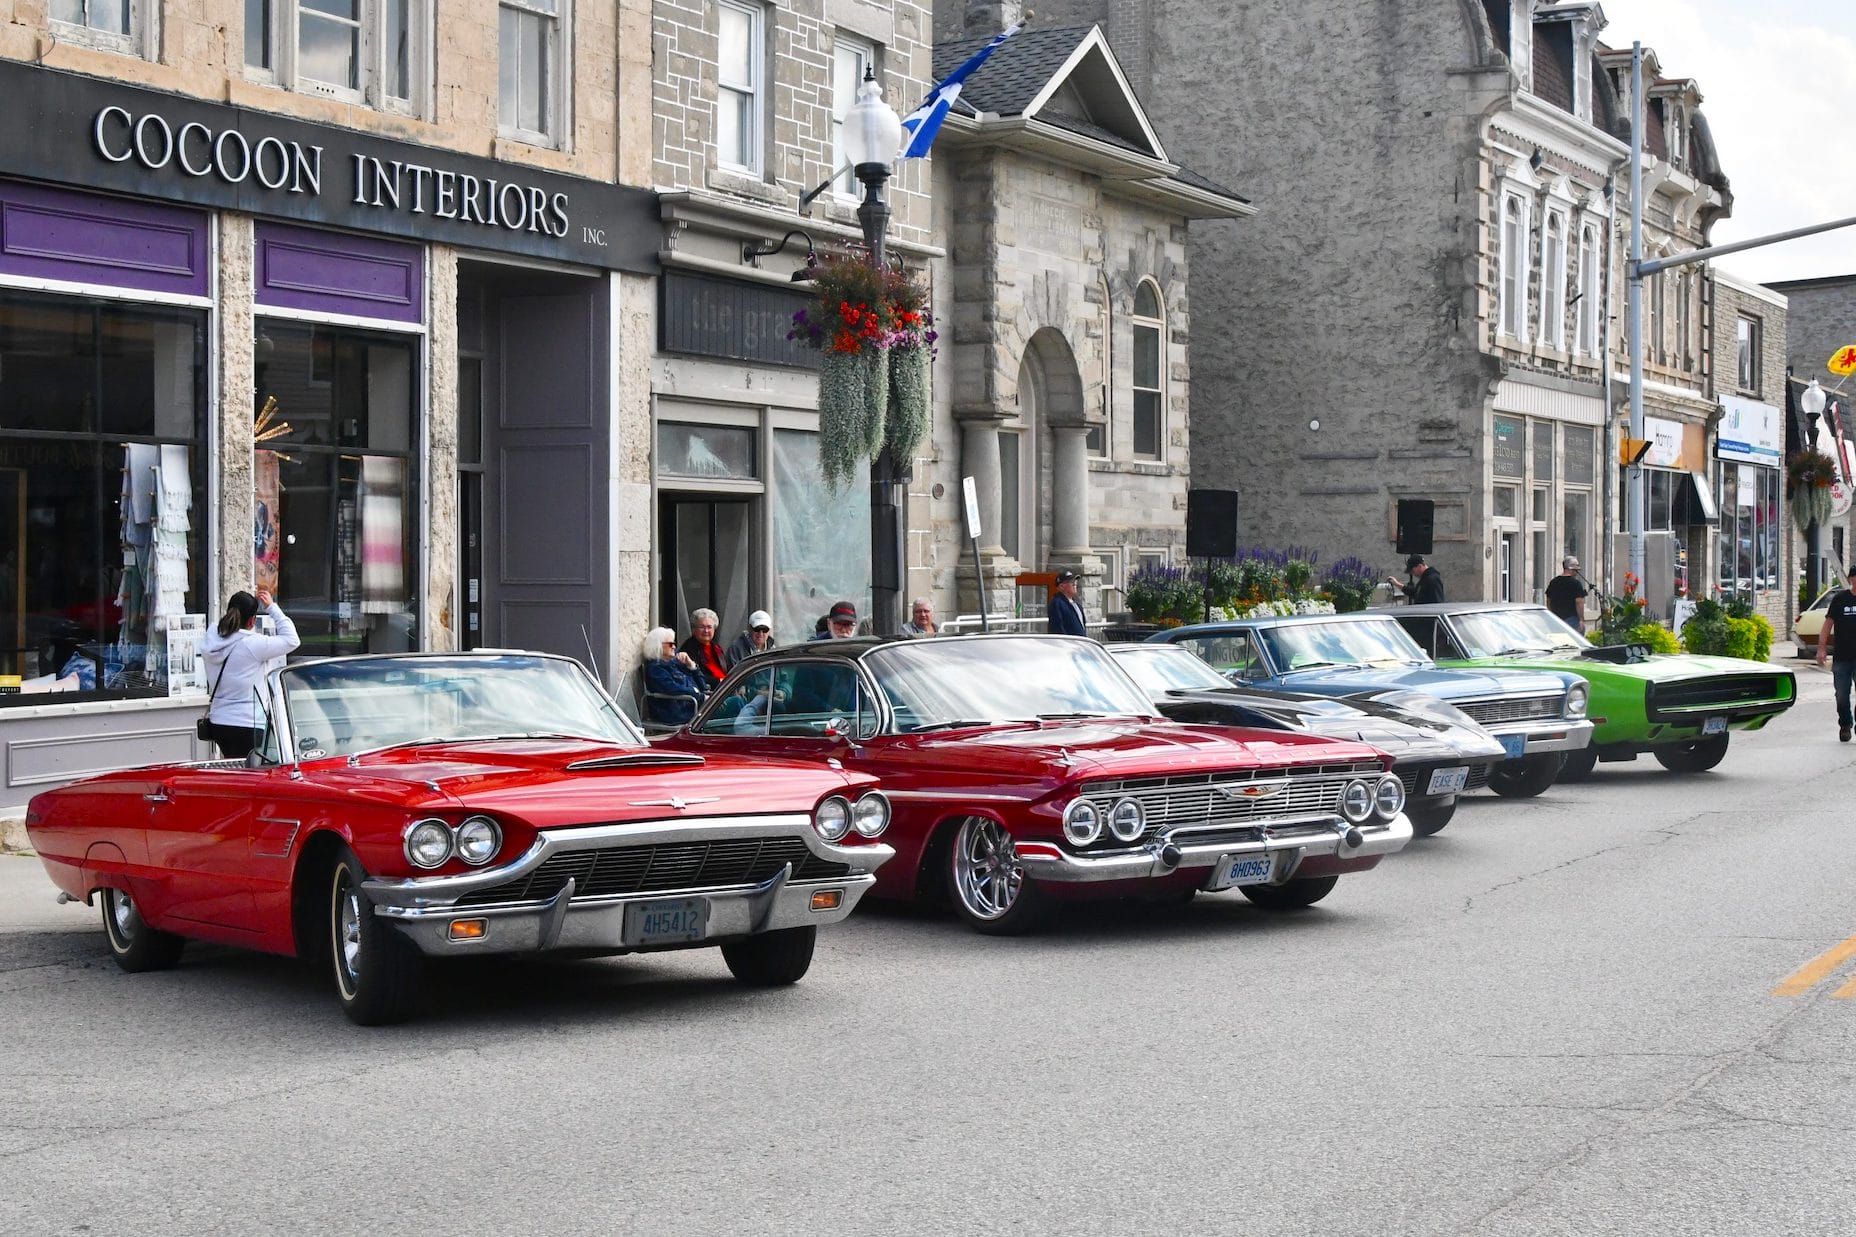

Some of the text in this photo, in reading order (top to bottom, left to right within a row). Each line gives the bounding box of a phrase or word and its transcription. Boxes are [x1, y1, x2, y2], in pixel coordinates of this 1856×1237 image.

[95, 106, 609, 247] COCOON INTERIORS INC.
[643, 910, 698, 934] 4H5412
